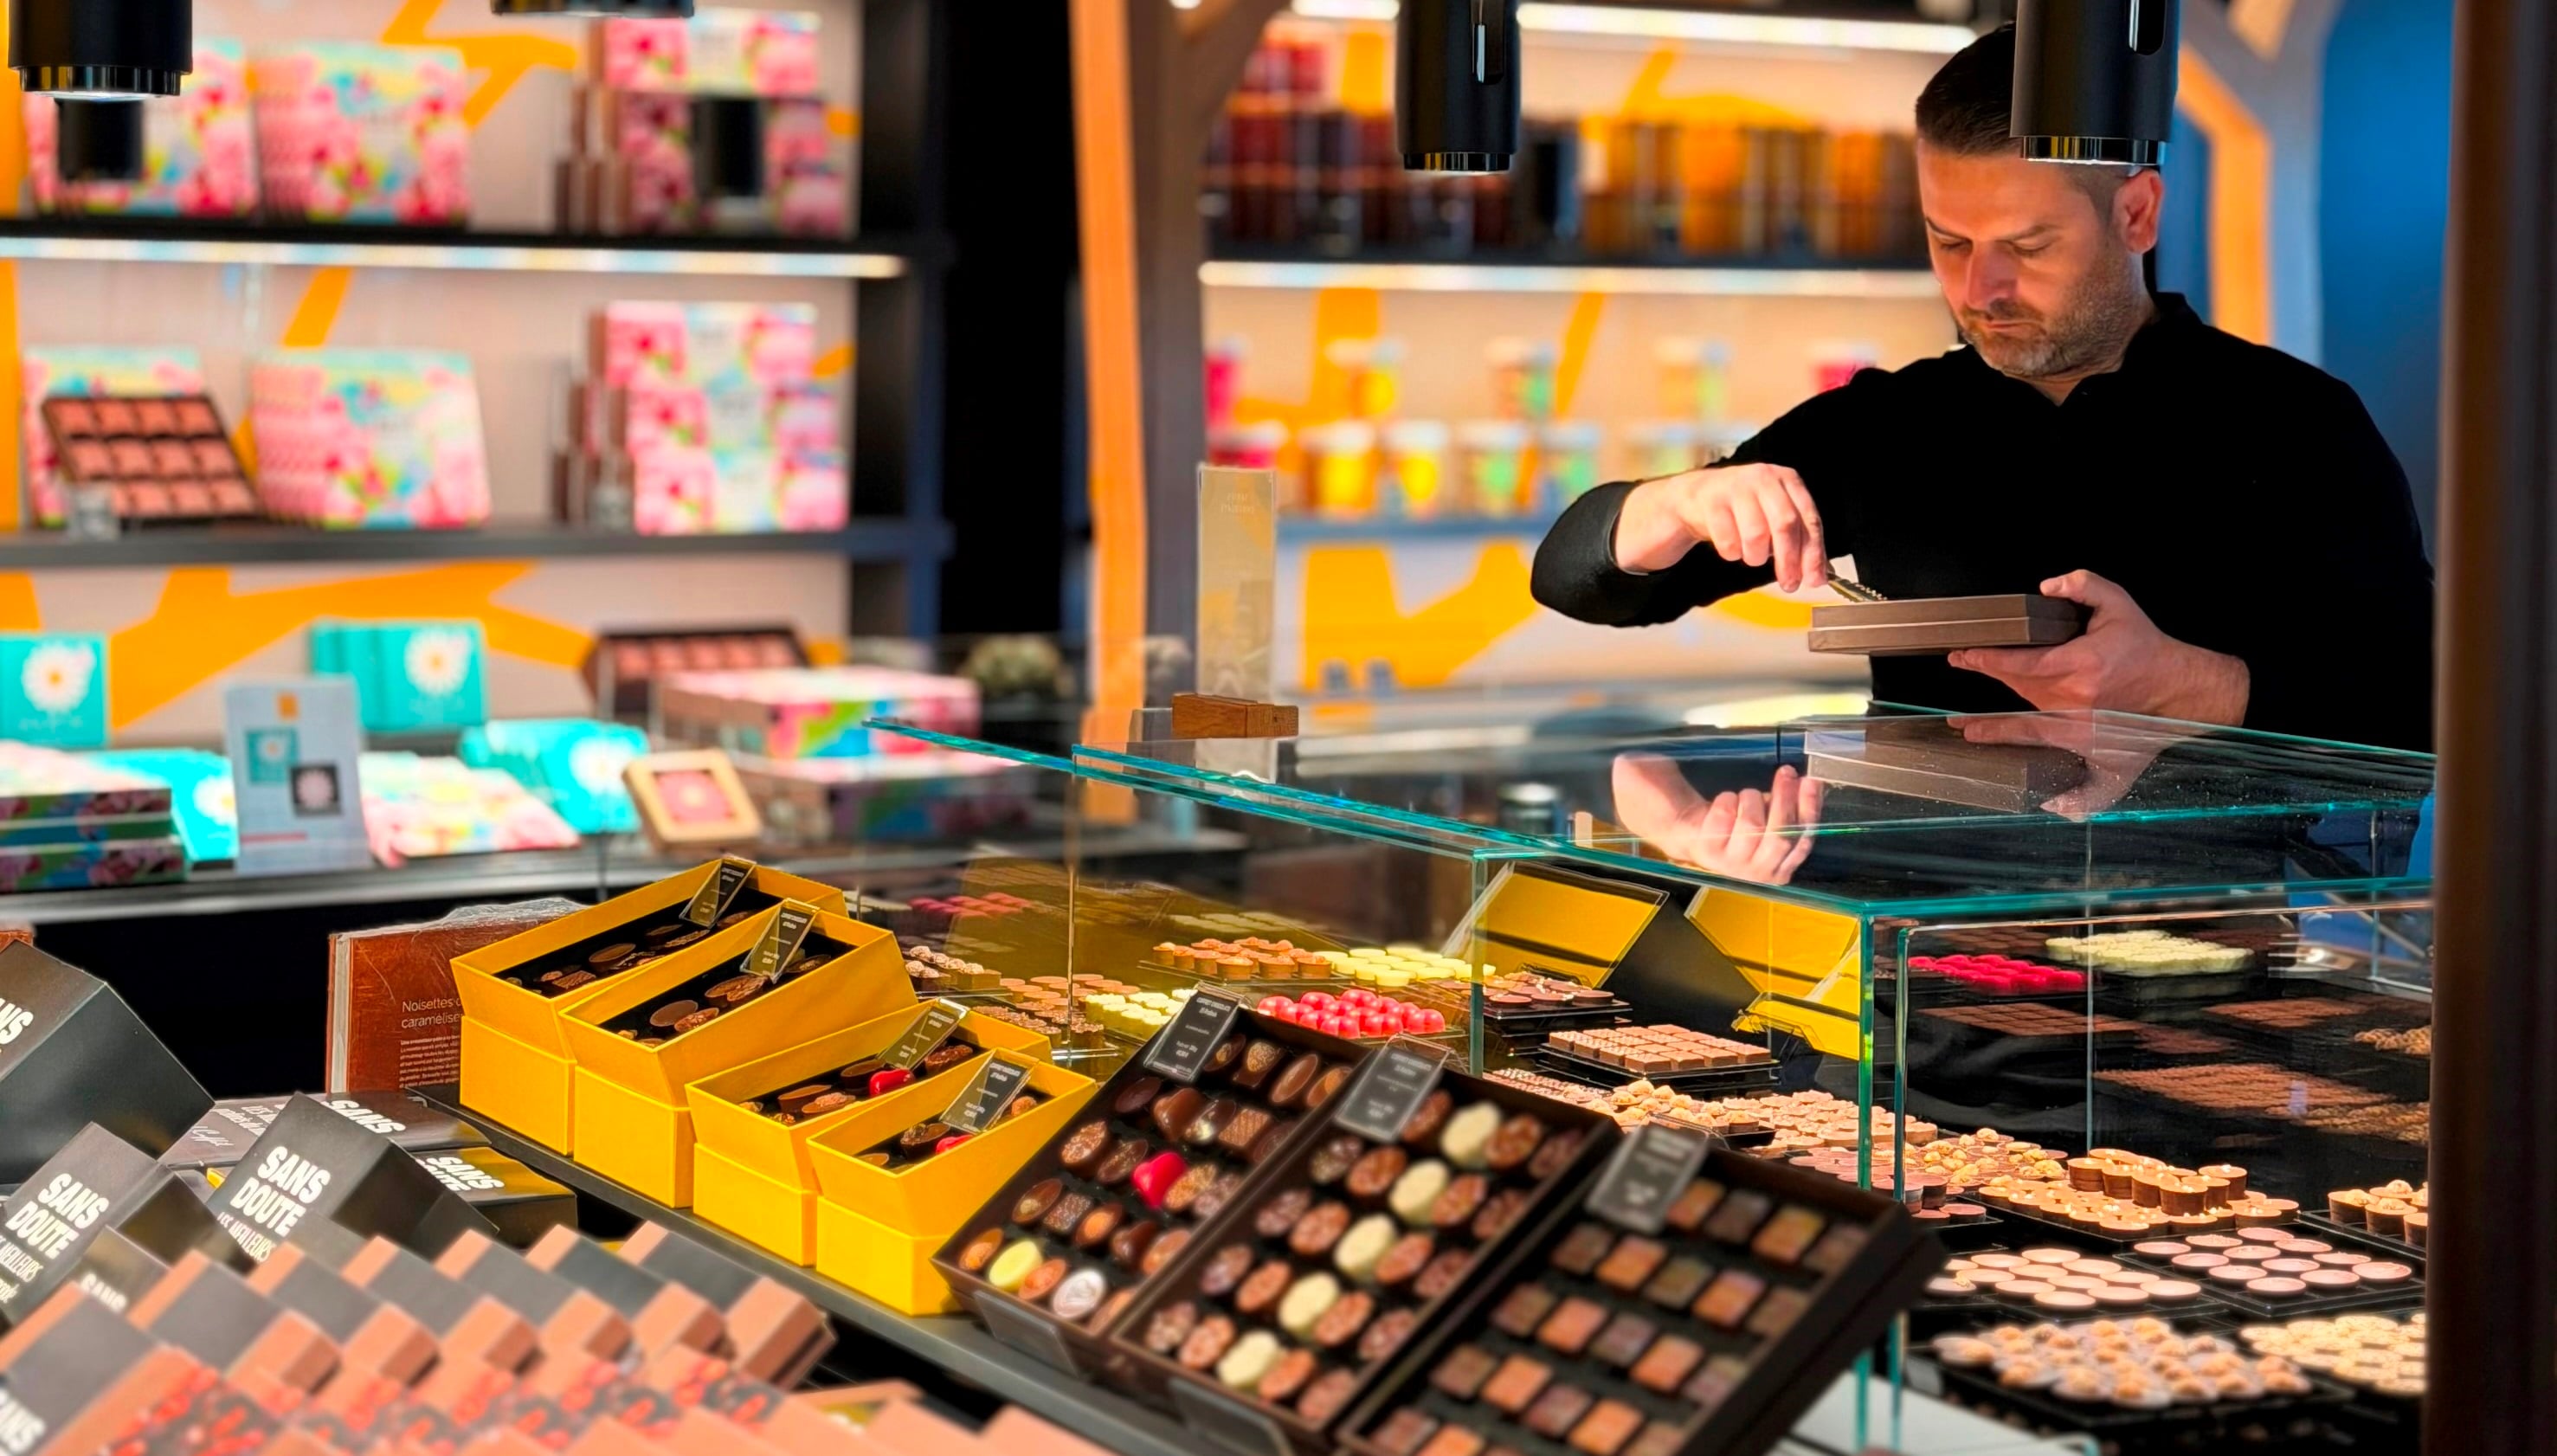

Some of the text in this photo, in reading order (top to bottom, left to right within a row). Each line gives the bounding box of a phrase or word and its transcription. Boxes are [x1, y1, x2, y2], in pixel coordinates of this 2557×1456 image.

[401, 1012, 463, 1028] caramélise
[402, 997, 454, 1012] Noisettes
[320, 1099, 406, 1134] SANS
[257, 1146, 331, 1203] SANS
[426, 1156, 505, 1189] SANS
[37, 1173, 109, 1229] SANS
[229, 1177, 306, 1238] DOUTE
[4, 1201, 80, 1260] DOUTE
